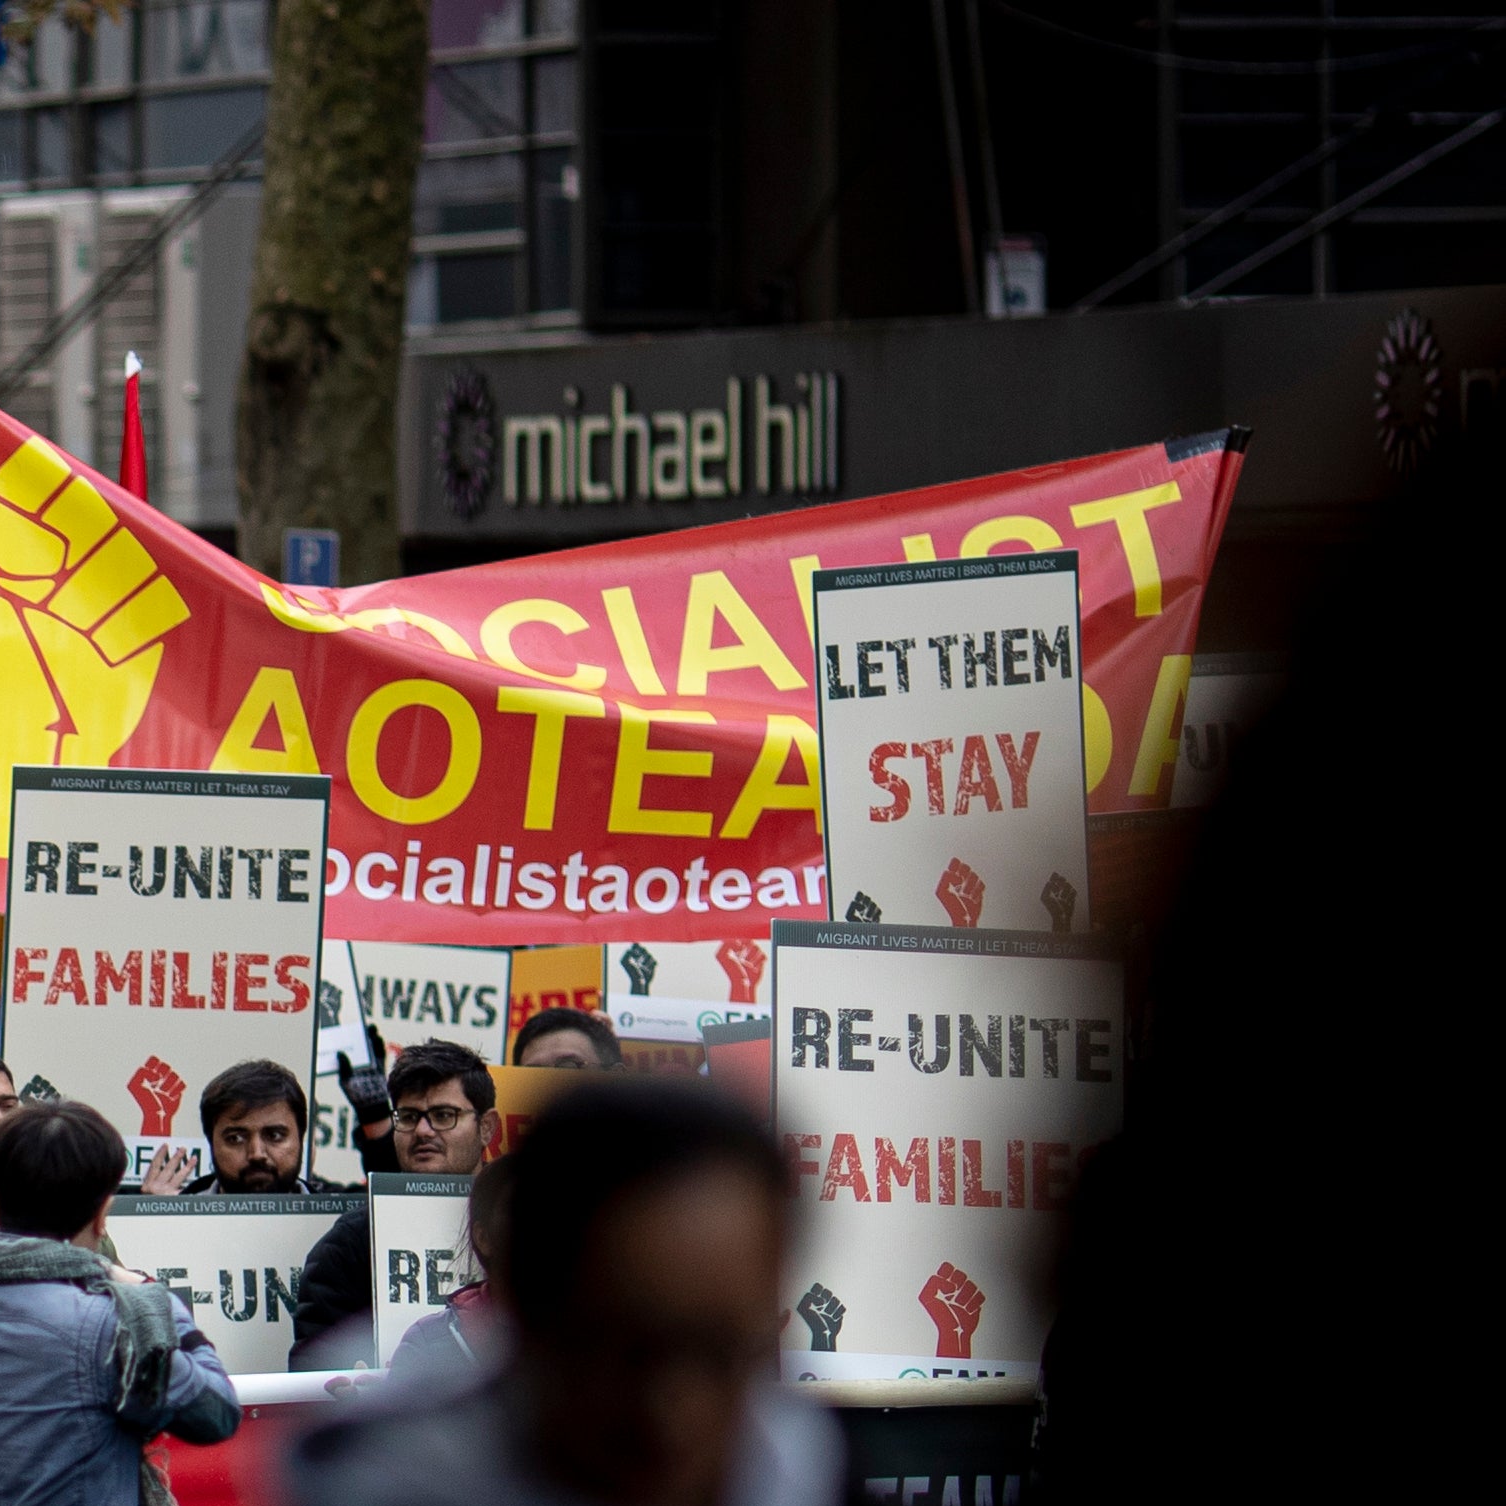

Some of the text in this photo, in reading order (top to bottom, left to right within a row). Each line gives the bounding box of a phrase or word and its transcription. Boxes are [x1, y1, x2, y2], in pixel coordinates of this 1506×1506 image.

[504, 370, 845, 506] michael hill
[835, 558, 1056, 587] MIGRANT LIVES MATTER BRING THEM BACK
[826, 625, 1072, 700] LET THEM
[51, 777, 291, 796] MIGRANT LIVES MATTER LET THEM STAY
[869, 731, 1041, 823] STAY
[24, 840, 311, 903] RE-UNITE
[816, 932, 1049, 955] MIGRANT LIVES MATTER LET THEM
[12, 946, 311, 1013] FAMILIES
[791, 1006, 1112, 1083] RE-UNITE
[406, 1181, 458, 1194] MIGRANT
[784, 1131, 1088, 1211] FAMILIE
[135, 1199, 343, 1214] MIGRANT LIVES MATTER LET THEM
